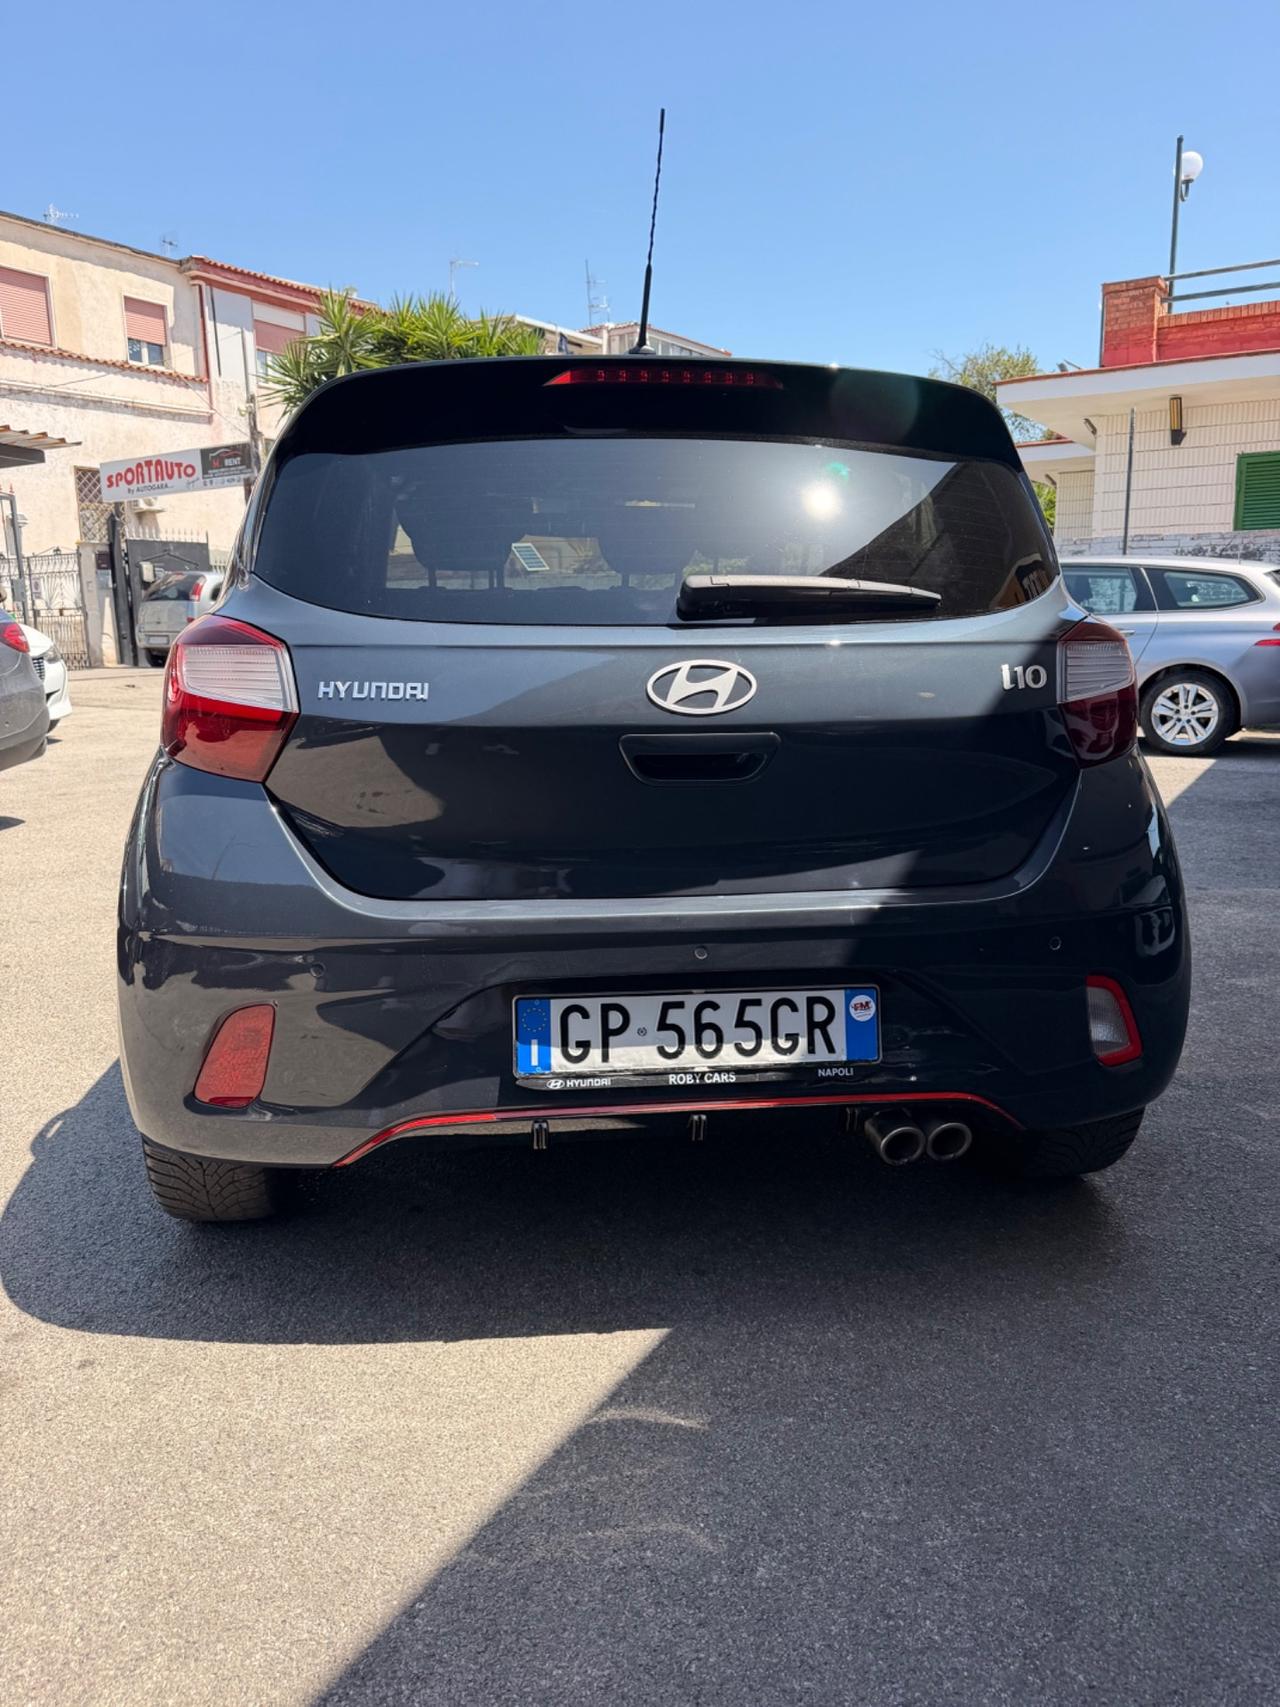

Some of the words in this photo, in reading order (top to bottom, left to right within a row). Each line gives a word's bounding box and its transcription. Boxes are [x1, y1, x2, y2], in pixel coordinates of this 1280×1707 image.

[107, 459, 196, 488] SPORTAUTO
[1001, 664, 1047, 690] i10
[318, 681, 429, 700] HYUNDAI
[560, 1002, 631, 1064] GP
[656, 996, 836, 1060] 565GR
[531, 1039, 538, 1066] I
[566, 1078, 611, 1088] HYUNDAI
[669, 1073, 701, 1085] ROBY
[704, 1072, 736, 1083] CARS
[818, 1068, 853, 1077] NAPOLI
